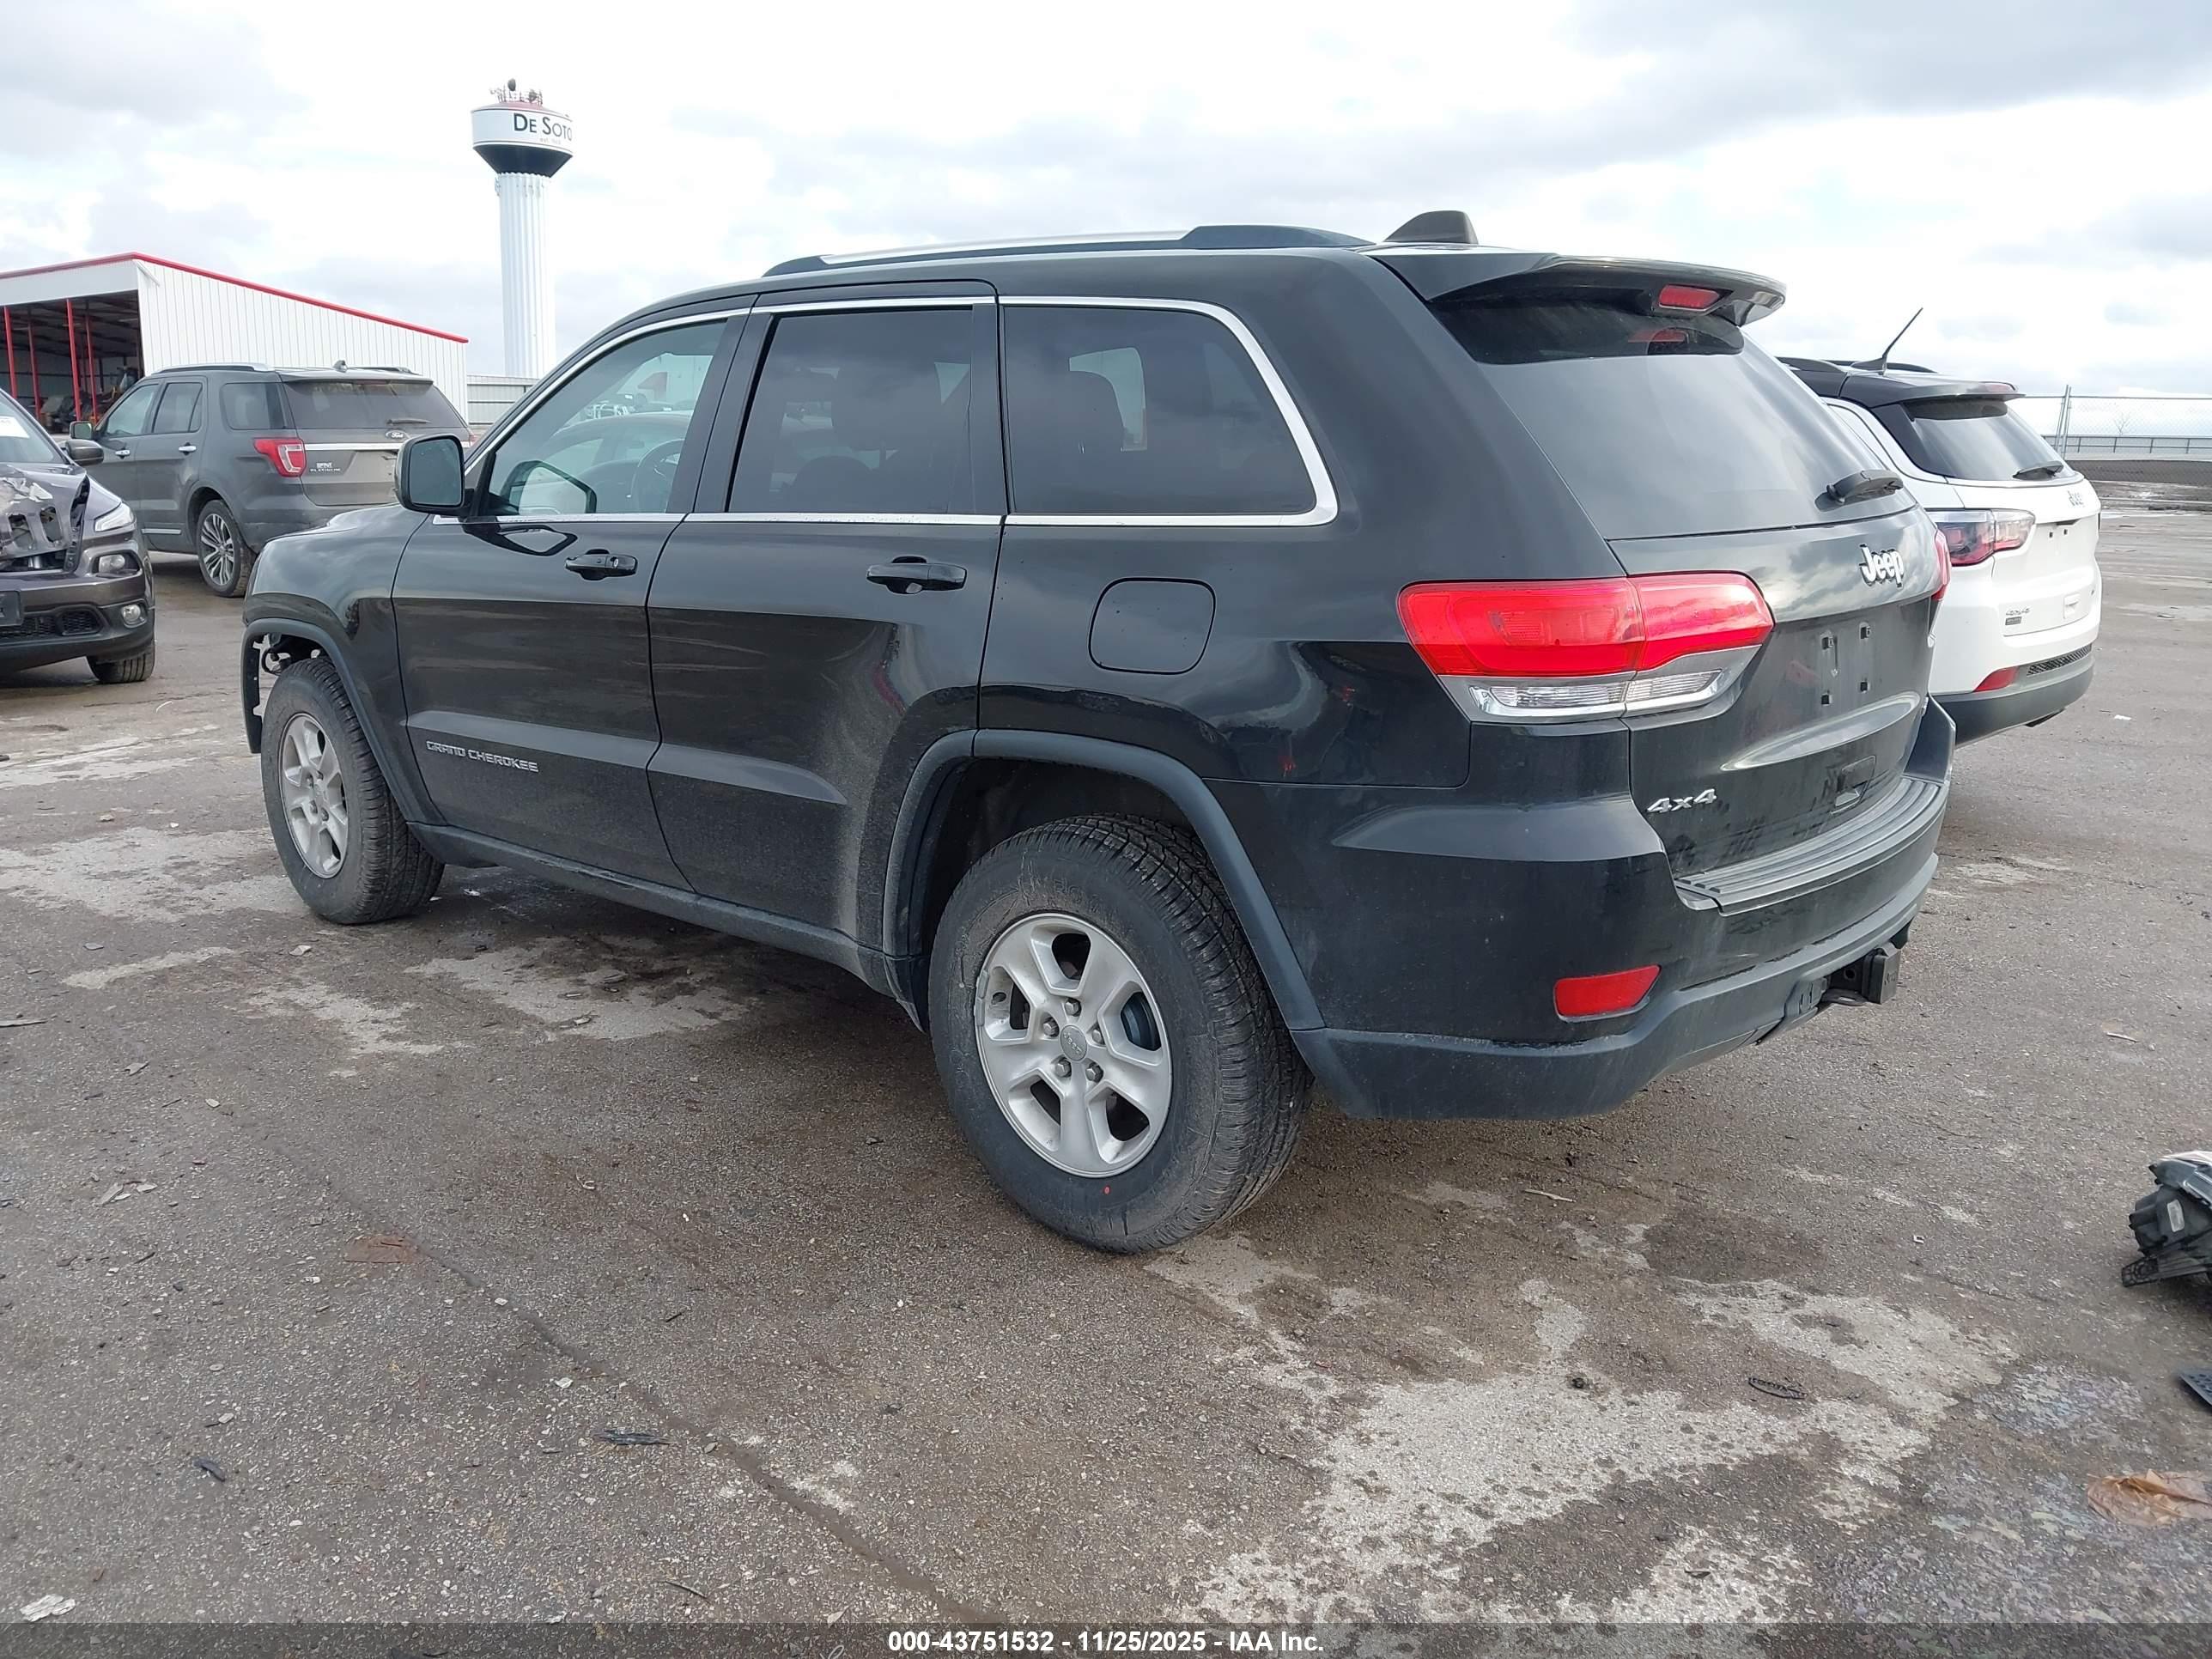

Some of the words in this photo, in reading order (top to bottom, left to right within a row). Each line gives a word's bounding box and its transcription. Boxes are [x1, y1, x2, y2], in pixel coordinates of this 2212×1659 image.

[1859, 544, 1905, 588] Jeep
[426, 740, 466, 757] GRAND
[468, 749, 538, 772] CHEROKEE
[1647, 788, 1717, 813] 4x4
